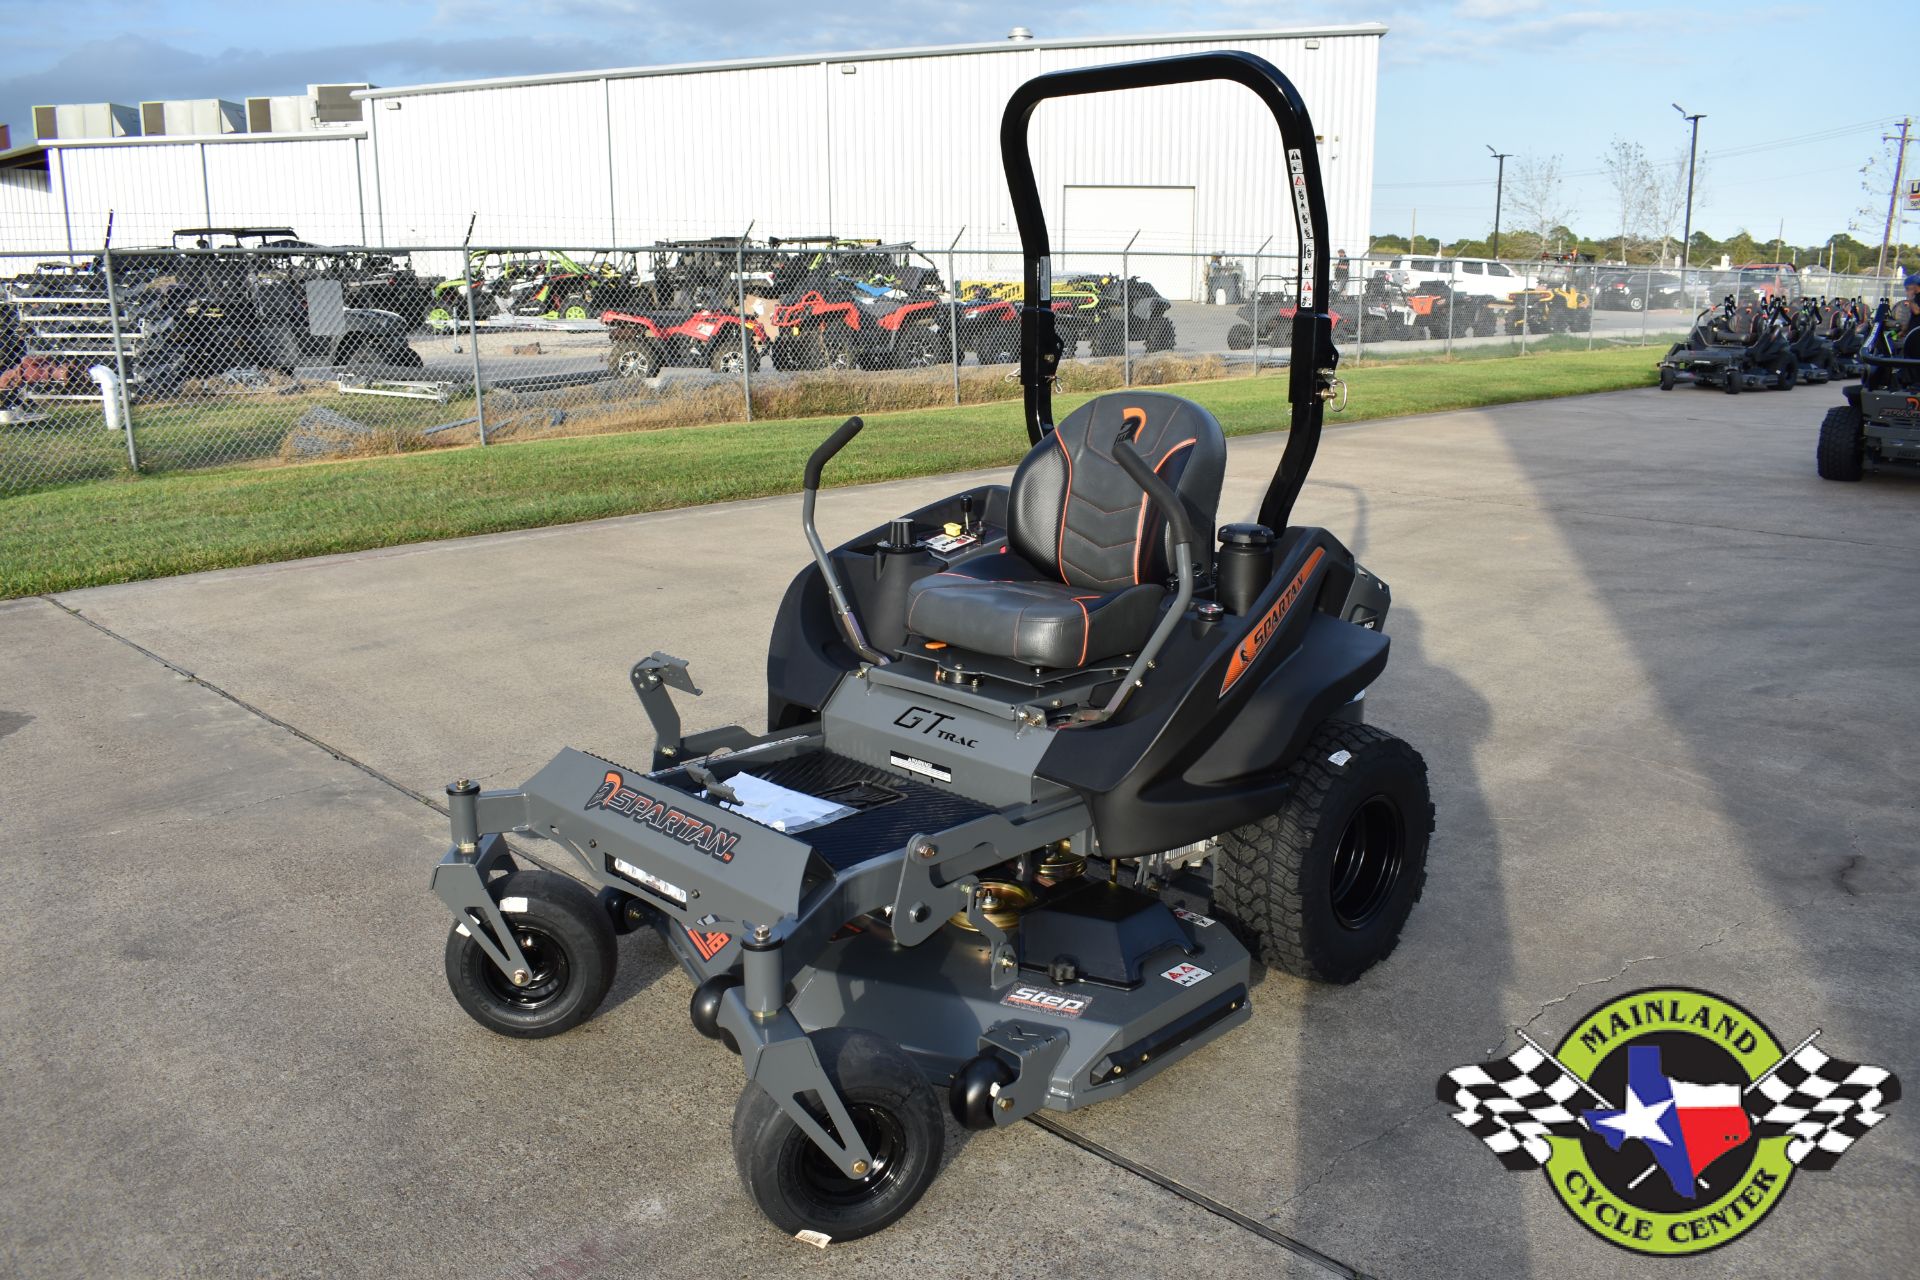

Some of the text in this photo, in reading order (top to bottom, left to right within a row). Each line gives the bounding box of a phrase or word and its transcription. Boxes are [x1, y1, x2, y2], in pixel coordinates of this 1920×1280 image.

[1253, 574, 1305, 645] SPARTAN
[893, 706, 956, 734] GT
[937, 729, 979, 749] TRAC
[607, 787, 738, 857] SPARTAN
